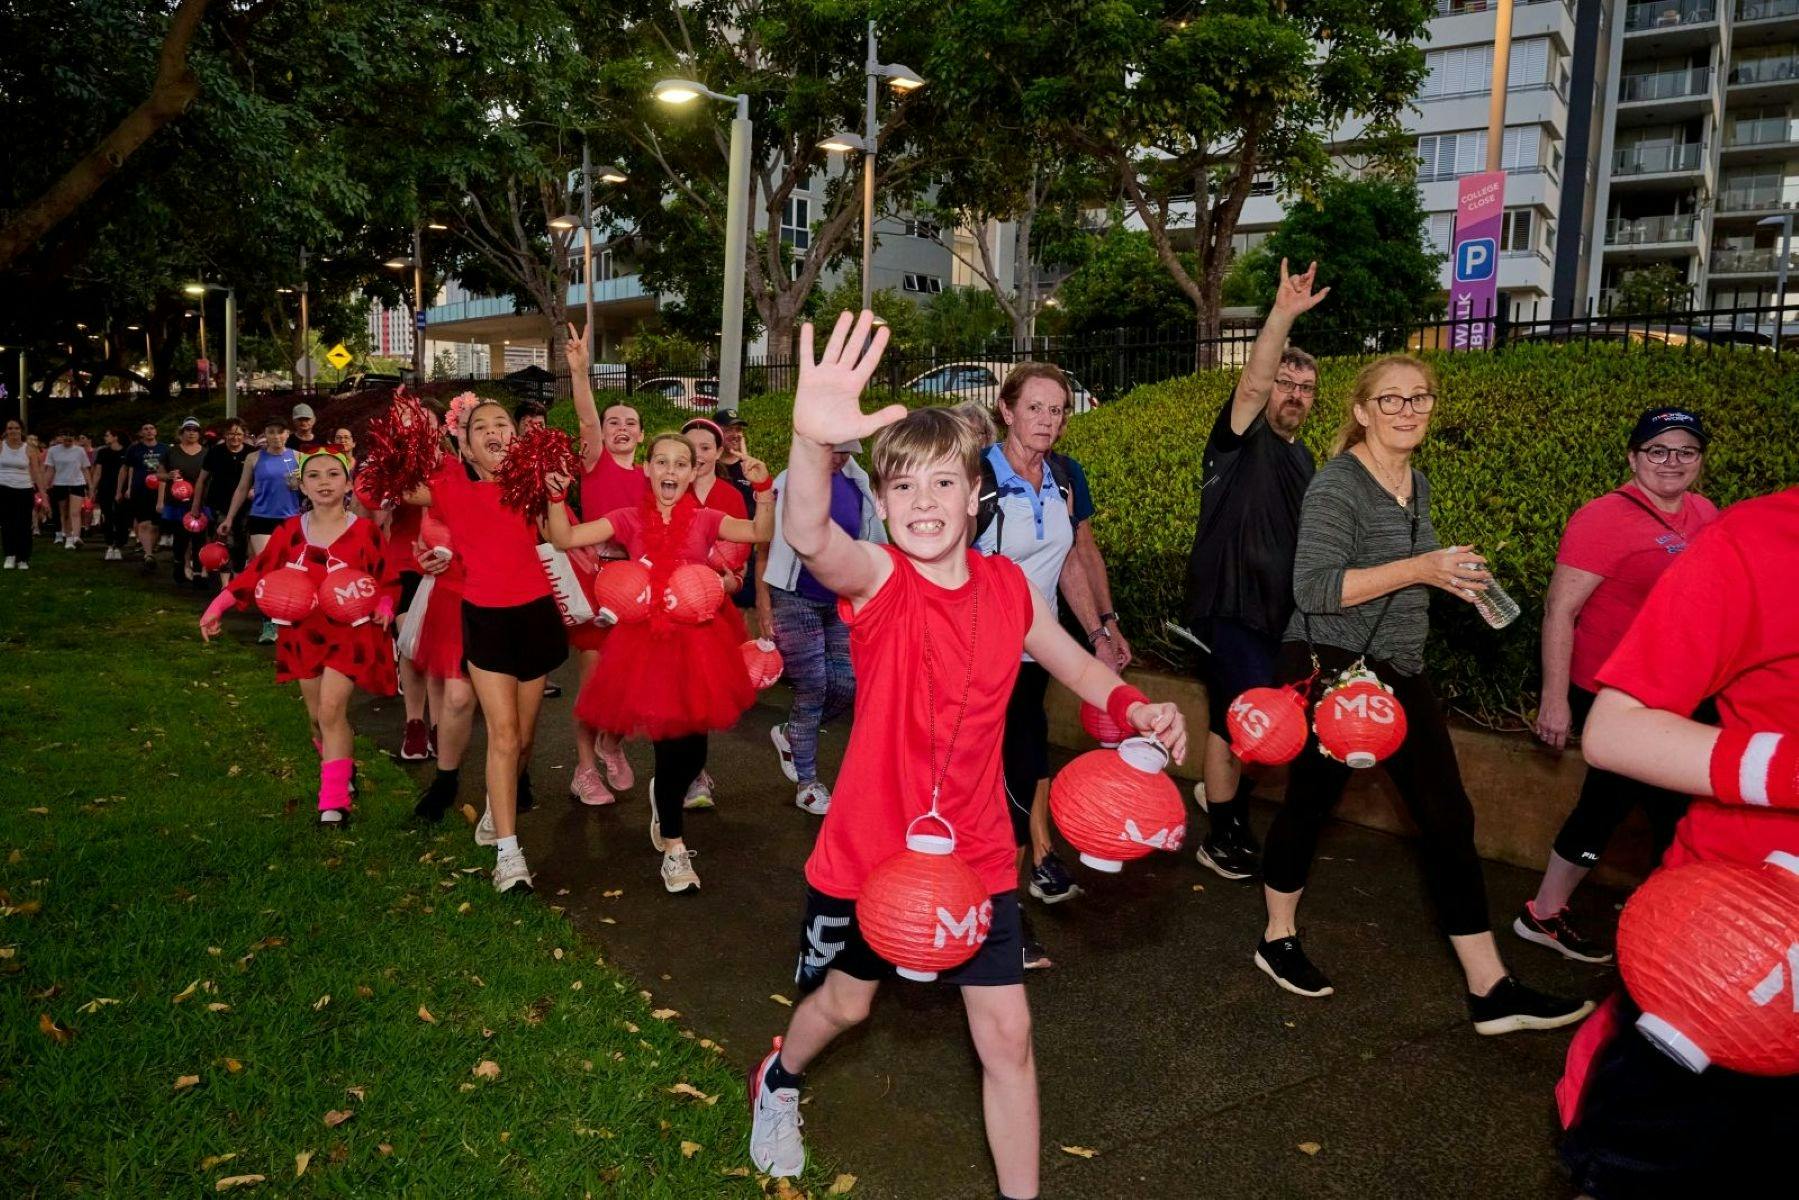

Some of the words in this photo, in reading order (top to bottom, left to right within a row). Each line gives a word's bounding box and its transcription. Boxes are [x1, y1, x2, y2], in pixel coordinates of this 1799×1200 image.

[1461, 182, 1500, 204] COLLEGE
[1468, 194, 1496, 211] CLOSE
[1466, 245, 1487, 275] P
[1470, 322, 1484, 349] BD
[334, 576, 377, 605] MS
[1229, 694, 1271, 739] MS
[1334, 693, 1395, 724] MS
[1581, 851, 1599, 860] FIL
